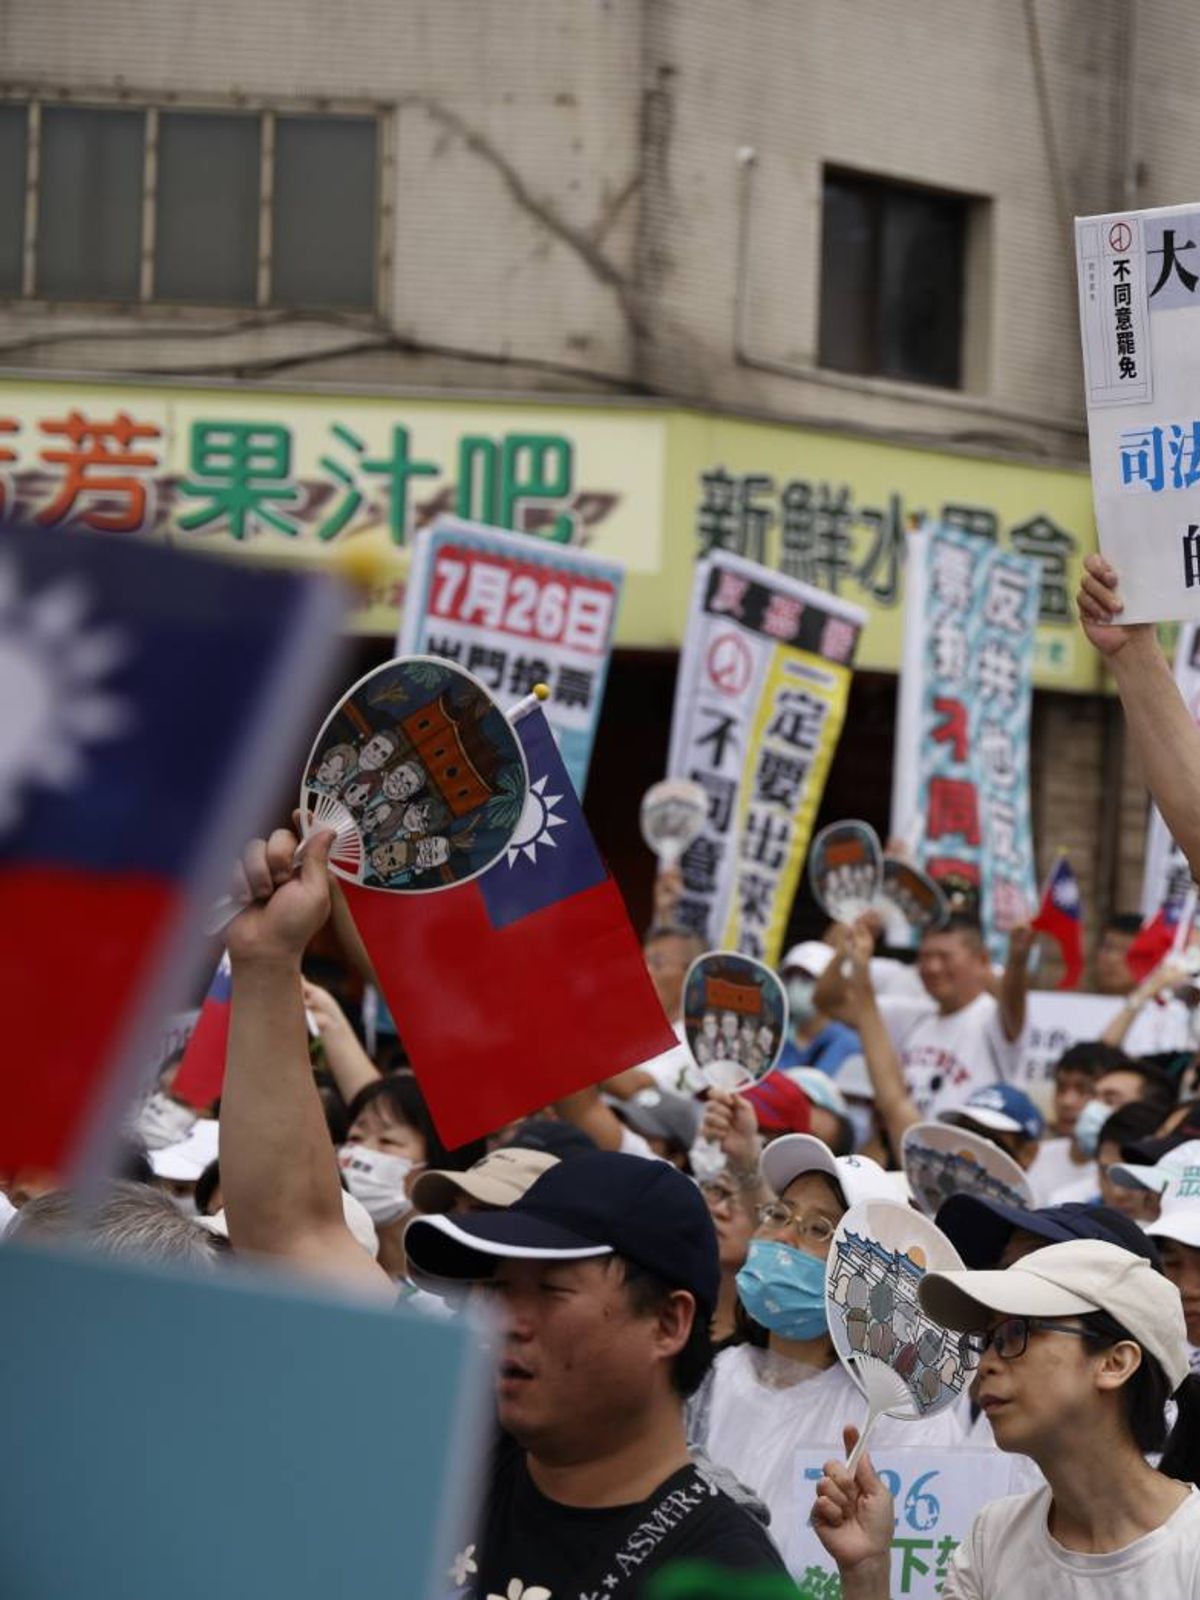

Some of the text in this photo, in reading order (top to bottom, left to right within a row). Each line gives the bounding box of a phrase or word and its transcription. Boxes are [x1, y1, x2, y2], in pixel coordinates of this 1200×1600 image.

[1112, 259, 1138, 381] 不同意罷免
[0, 408, 576, 545] 芳果汁吧
[434, 558, 611, 652] 7月26日
